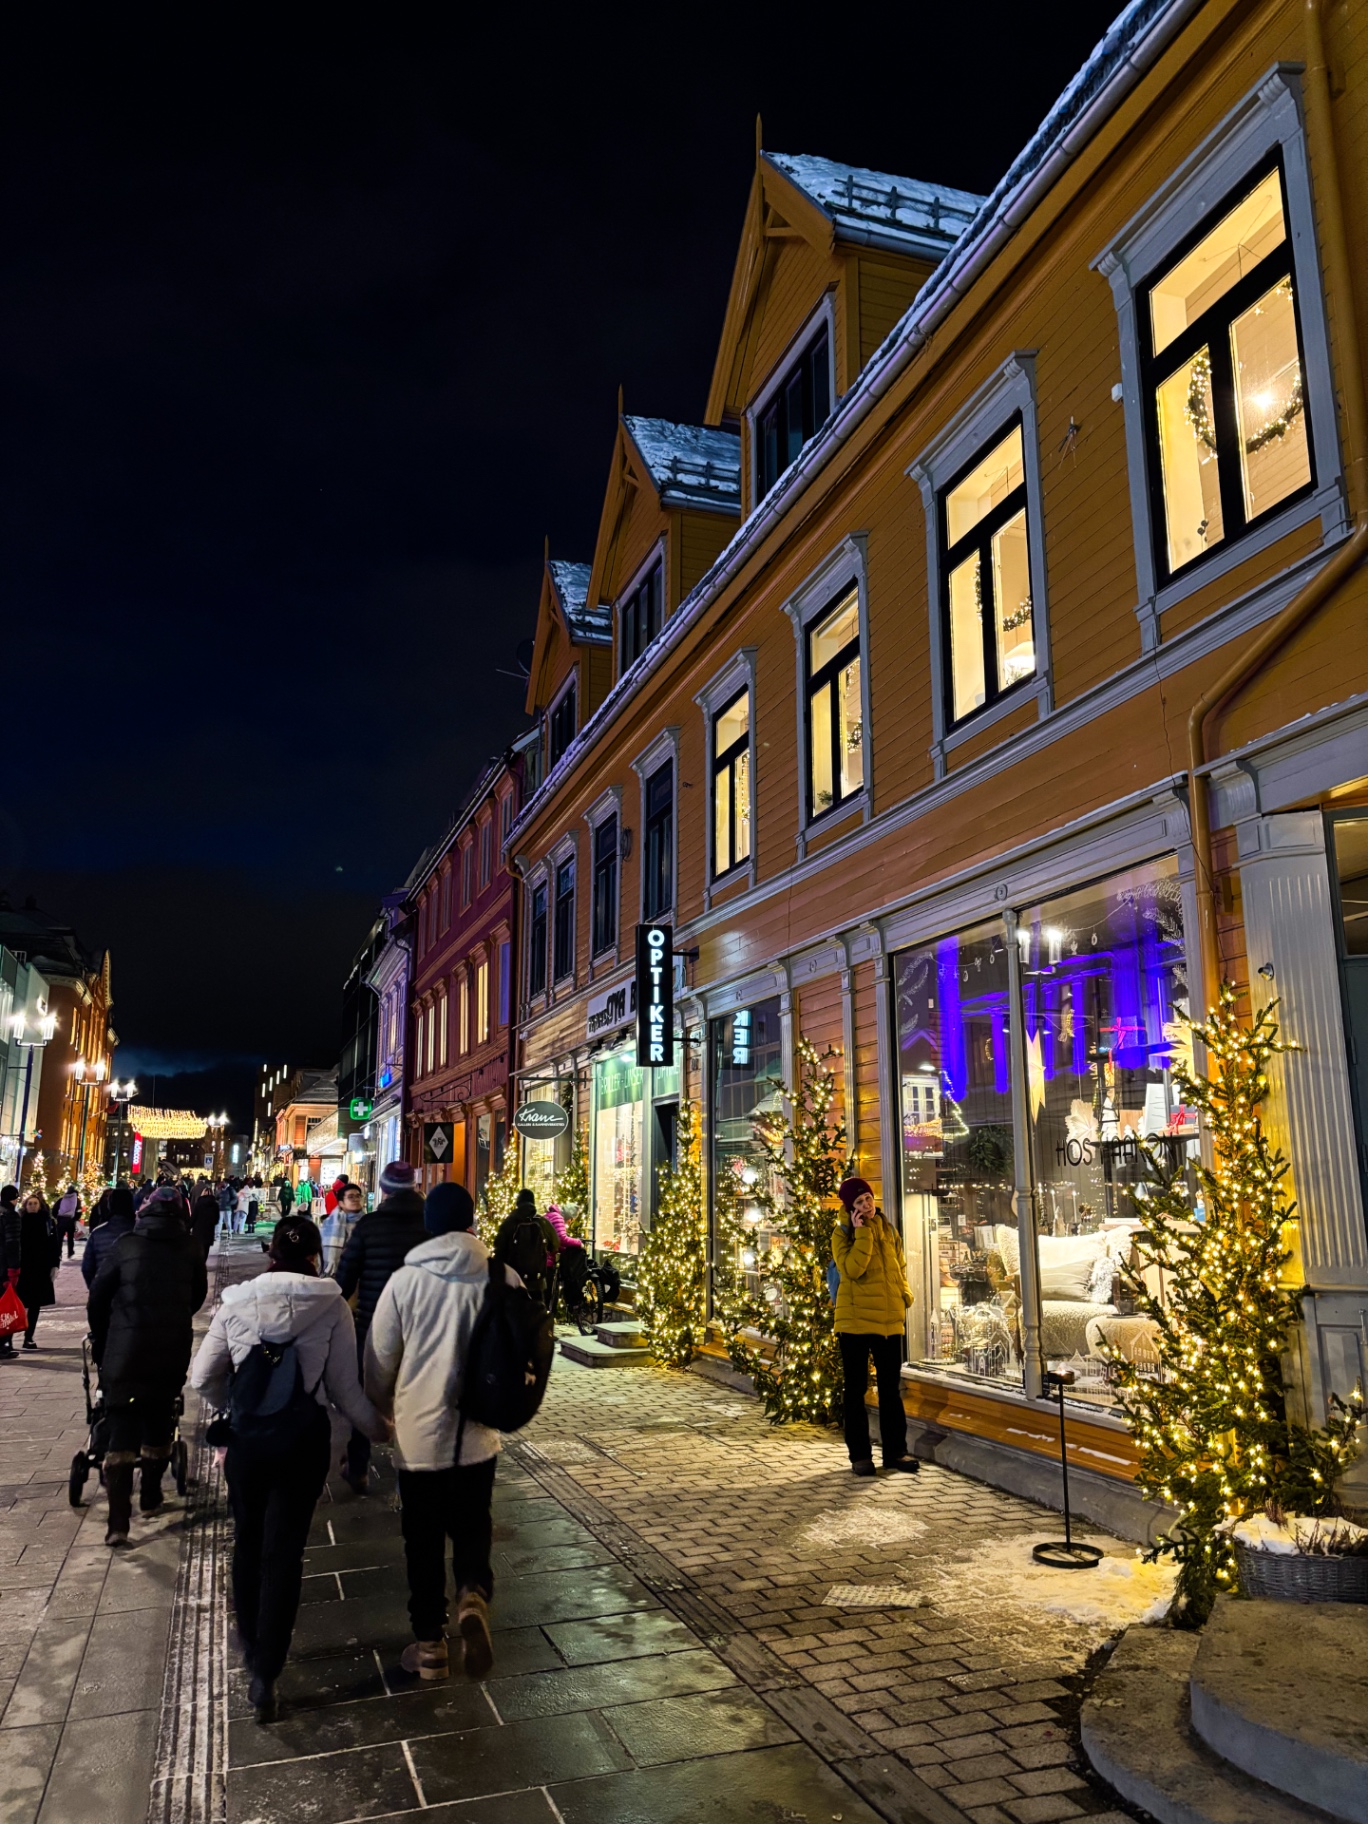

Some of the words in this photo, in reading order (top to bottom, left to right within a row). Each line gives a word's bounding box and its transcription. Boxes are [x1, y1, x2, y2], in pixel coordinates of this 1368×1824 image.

[647, 929, 665, 1062] OPTIKER
[518, 1108, 564, 1122] Krane
[1055, 1138, 1093, 1167] HOS
